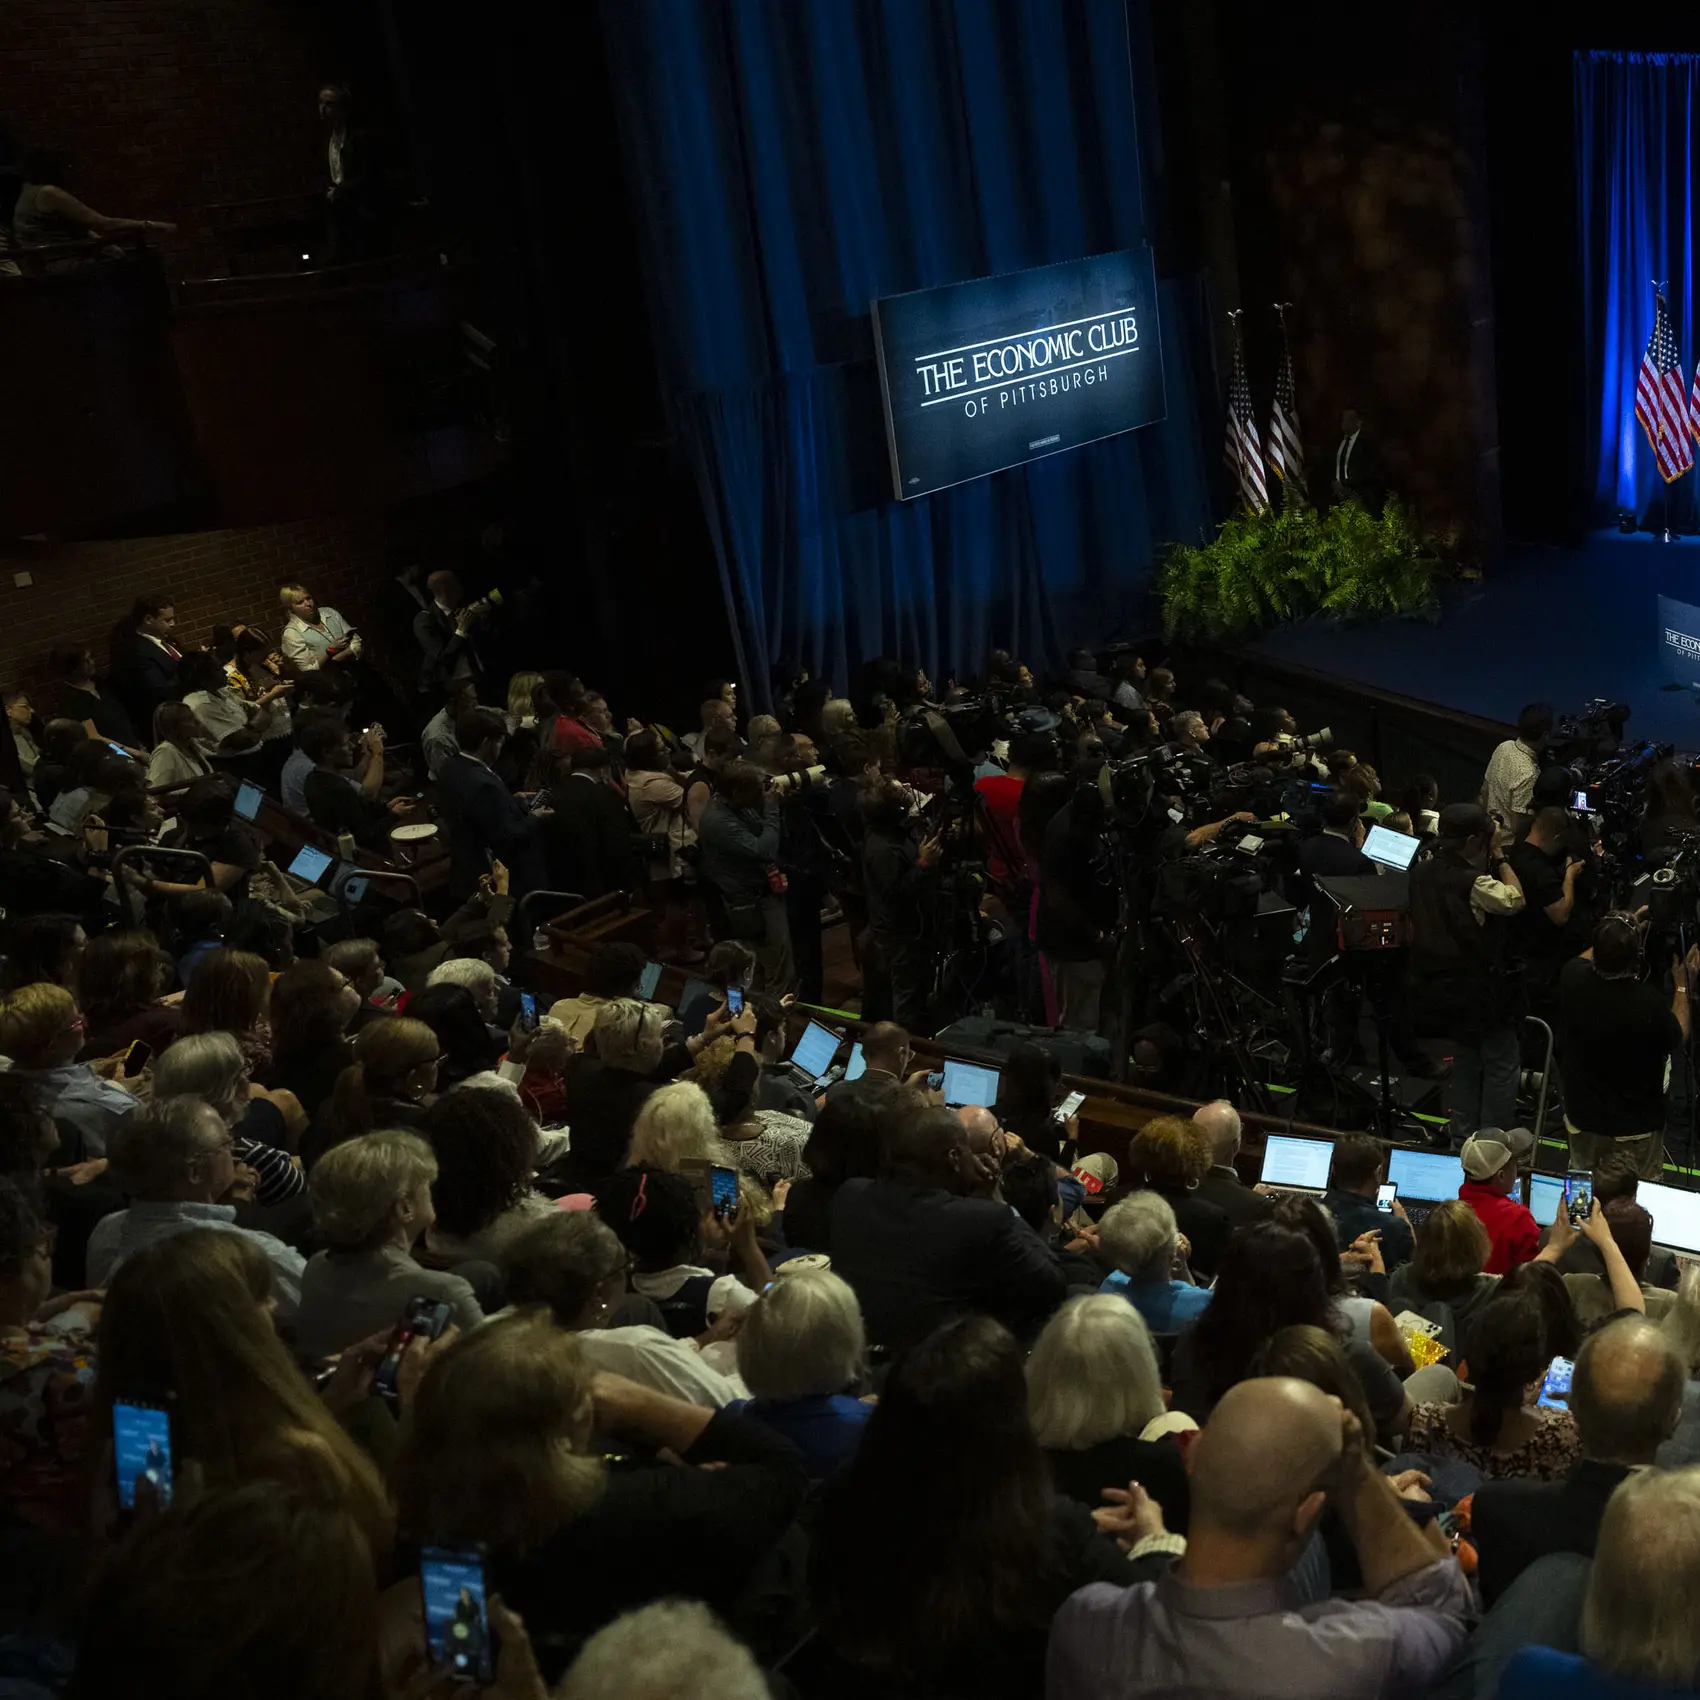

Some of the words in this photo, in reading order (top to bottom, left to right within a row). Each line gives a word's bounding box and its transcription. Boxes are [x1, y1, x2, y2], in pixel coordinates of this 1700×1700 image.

[917, 358, 967, 395] THE
[972, 330, 1084, 382] ECONOMIC
[1088, 317, 1138, 351] CLUB
[965, 397, 988, 417] OF
[1000, 365, 1108, 408] PITTSBURGH
[1665, 631, 1679, 644] THE
